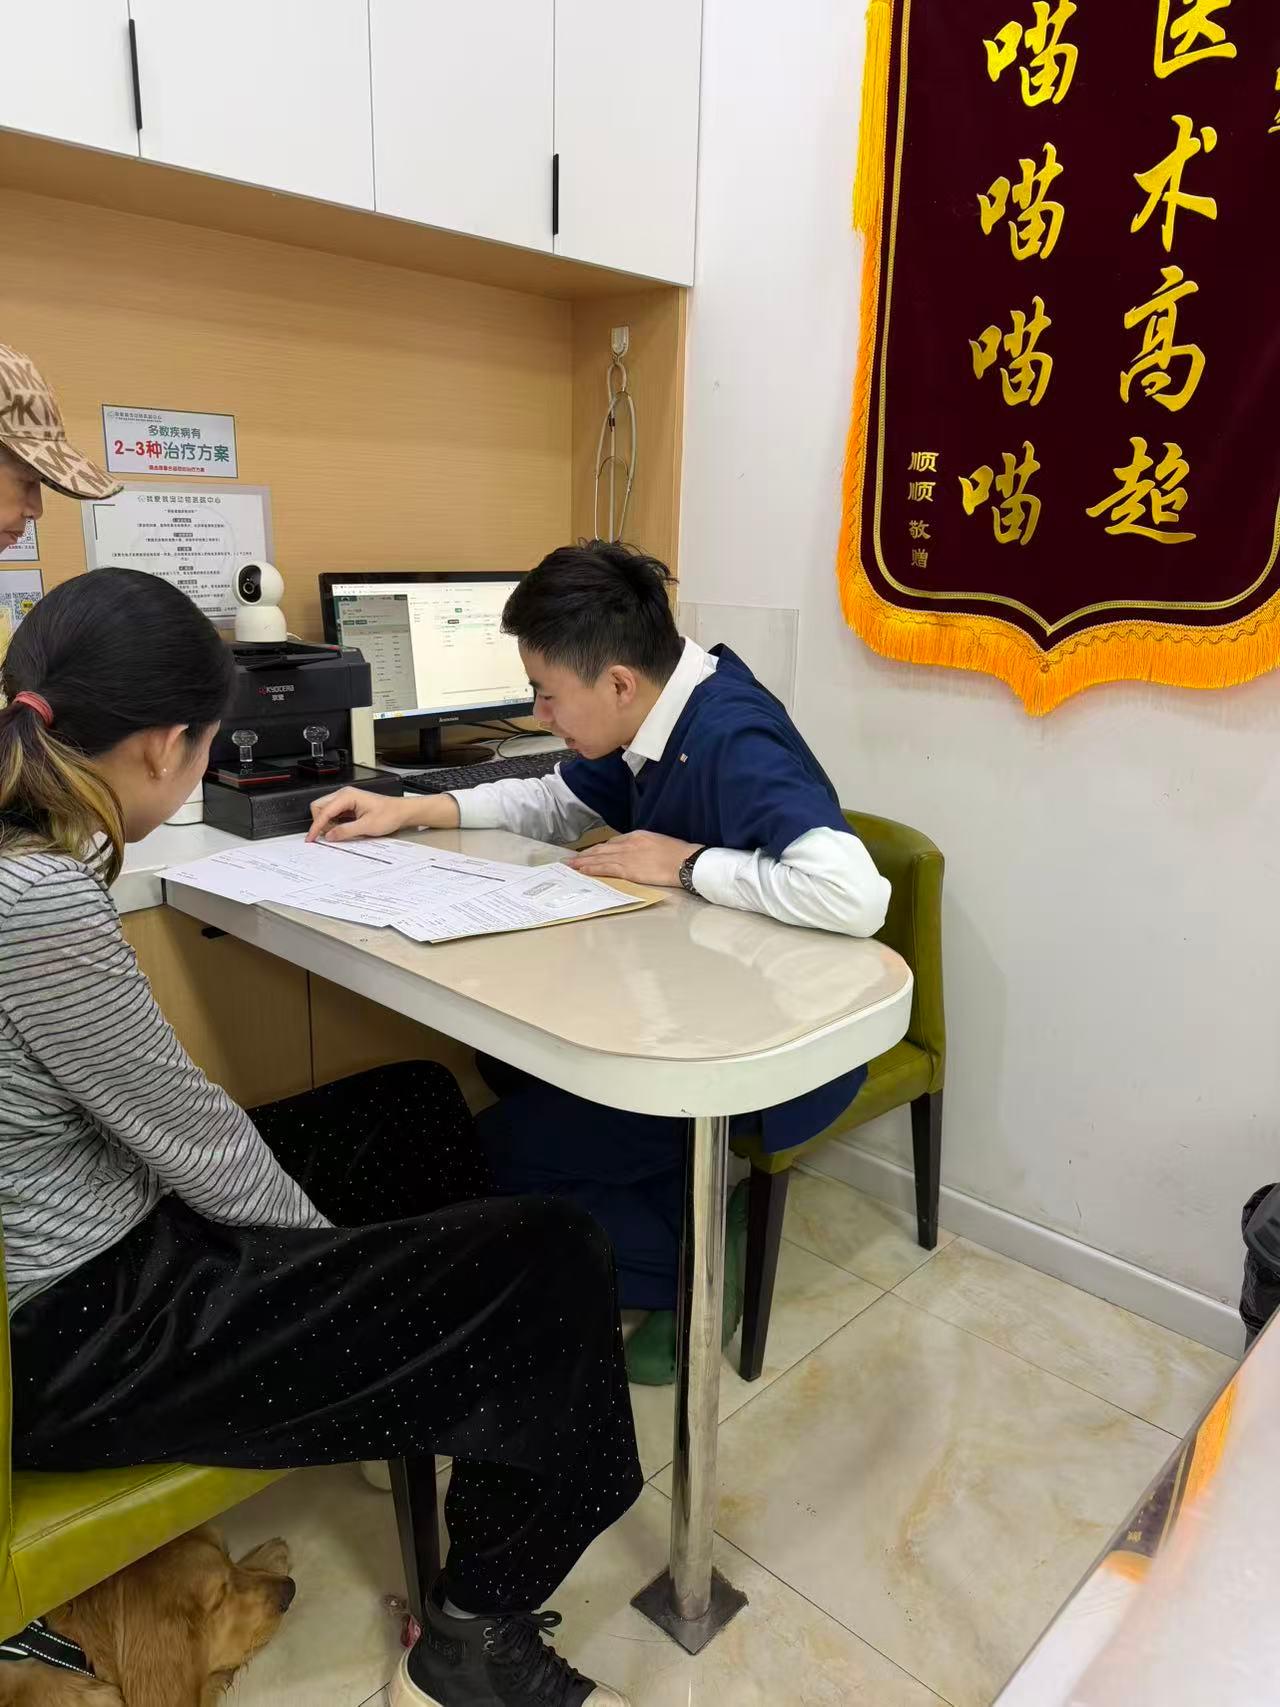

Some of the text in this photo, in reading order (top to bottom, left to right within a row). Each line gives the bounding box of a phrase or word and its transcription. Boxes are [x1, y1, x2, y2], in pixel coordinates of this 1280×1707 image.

[959, 0, 1079, 546] 喵喵喵喵
[1086, 0, 1237, 543] 医术高超
[148, 424, 201, 439] 多数疾病有
[907, 451, 939, 569] 顺顺 敬赠
[266, 684, 295, 693] KYOCERA
